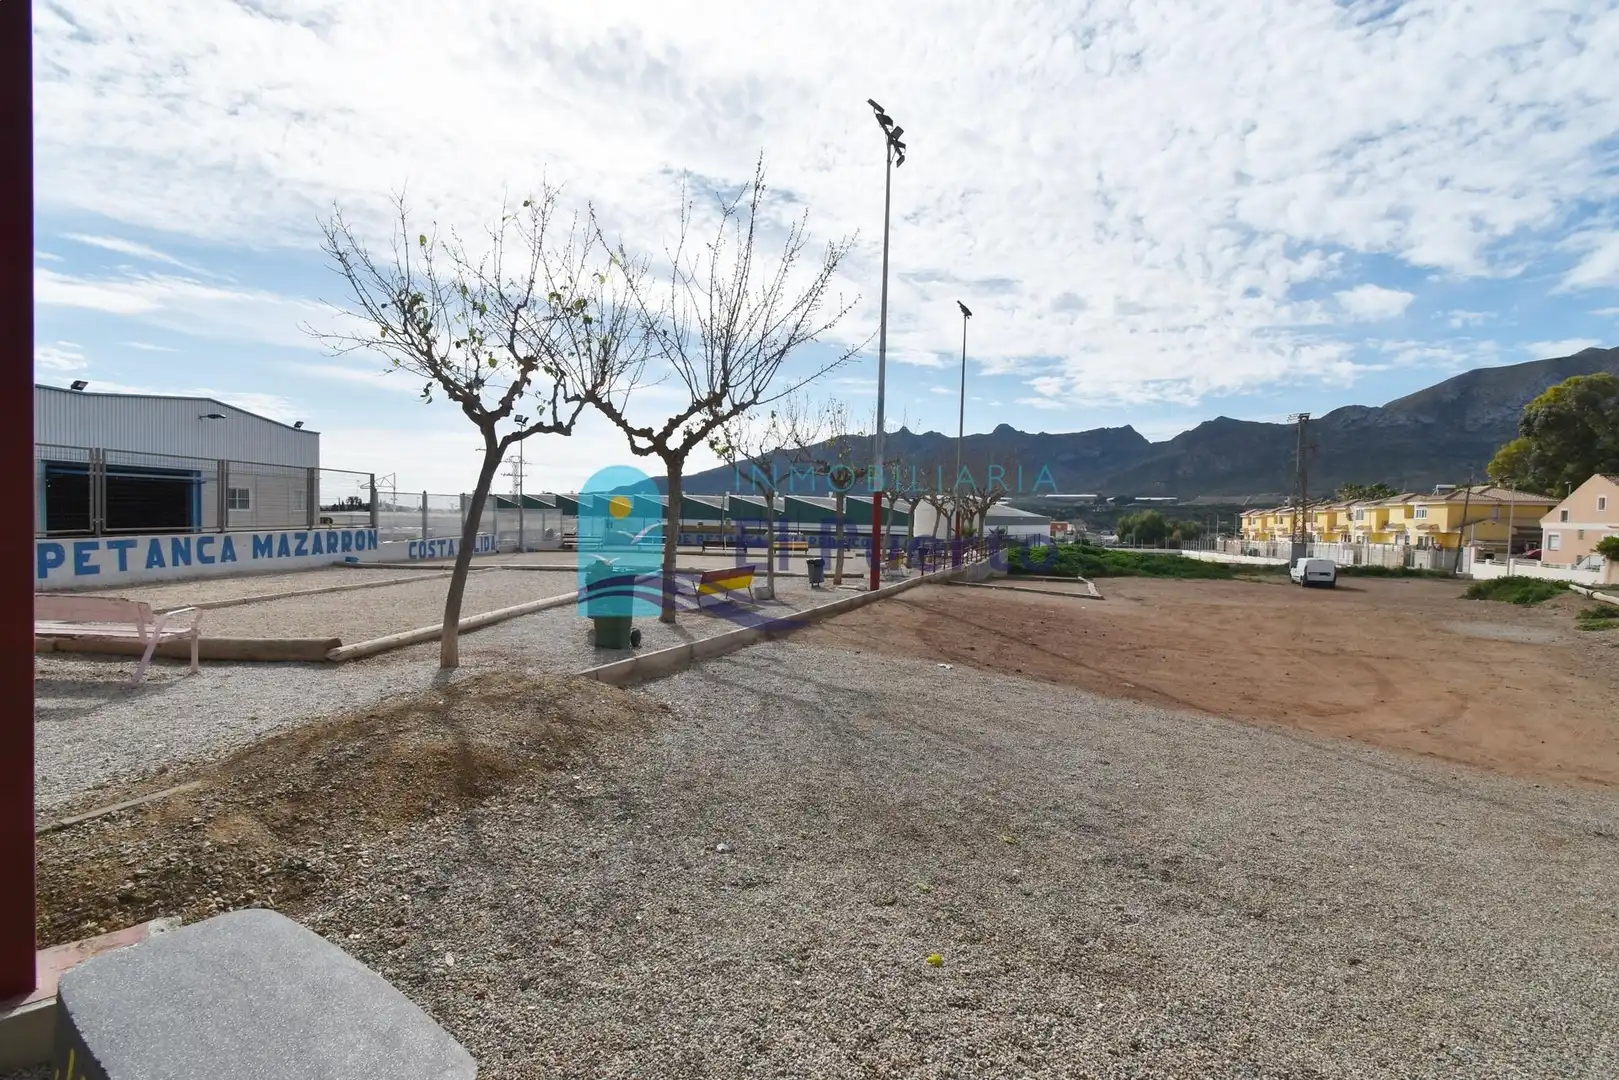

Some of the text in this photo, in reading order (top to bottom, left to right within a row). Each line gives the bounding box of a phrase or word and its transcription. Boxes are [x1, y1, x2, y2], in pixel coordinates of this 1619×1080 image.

[37, 529, 378, 578] PETANCA MAZARRON
[408, 538, 455, 559] COSTA
